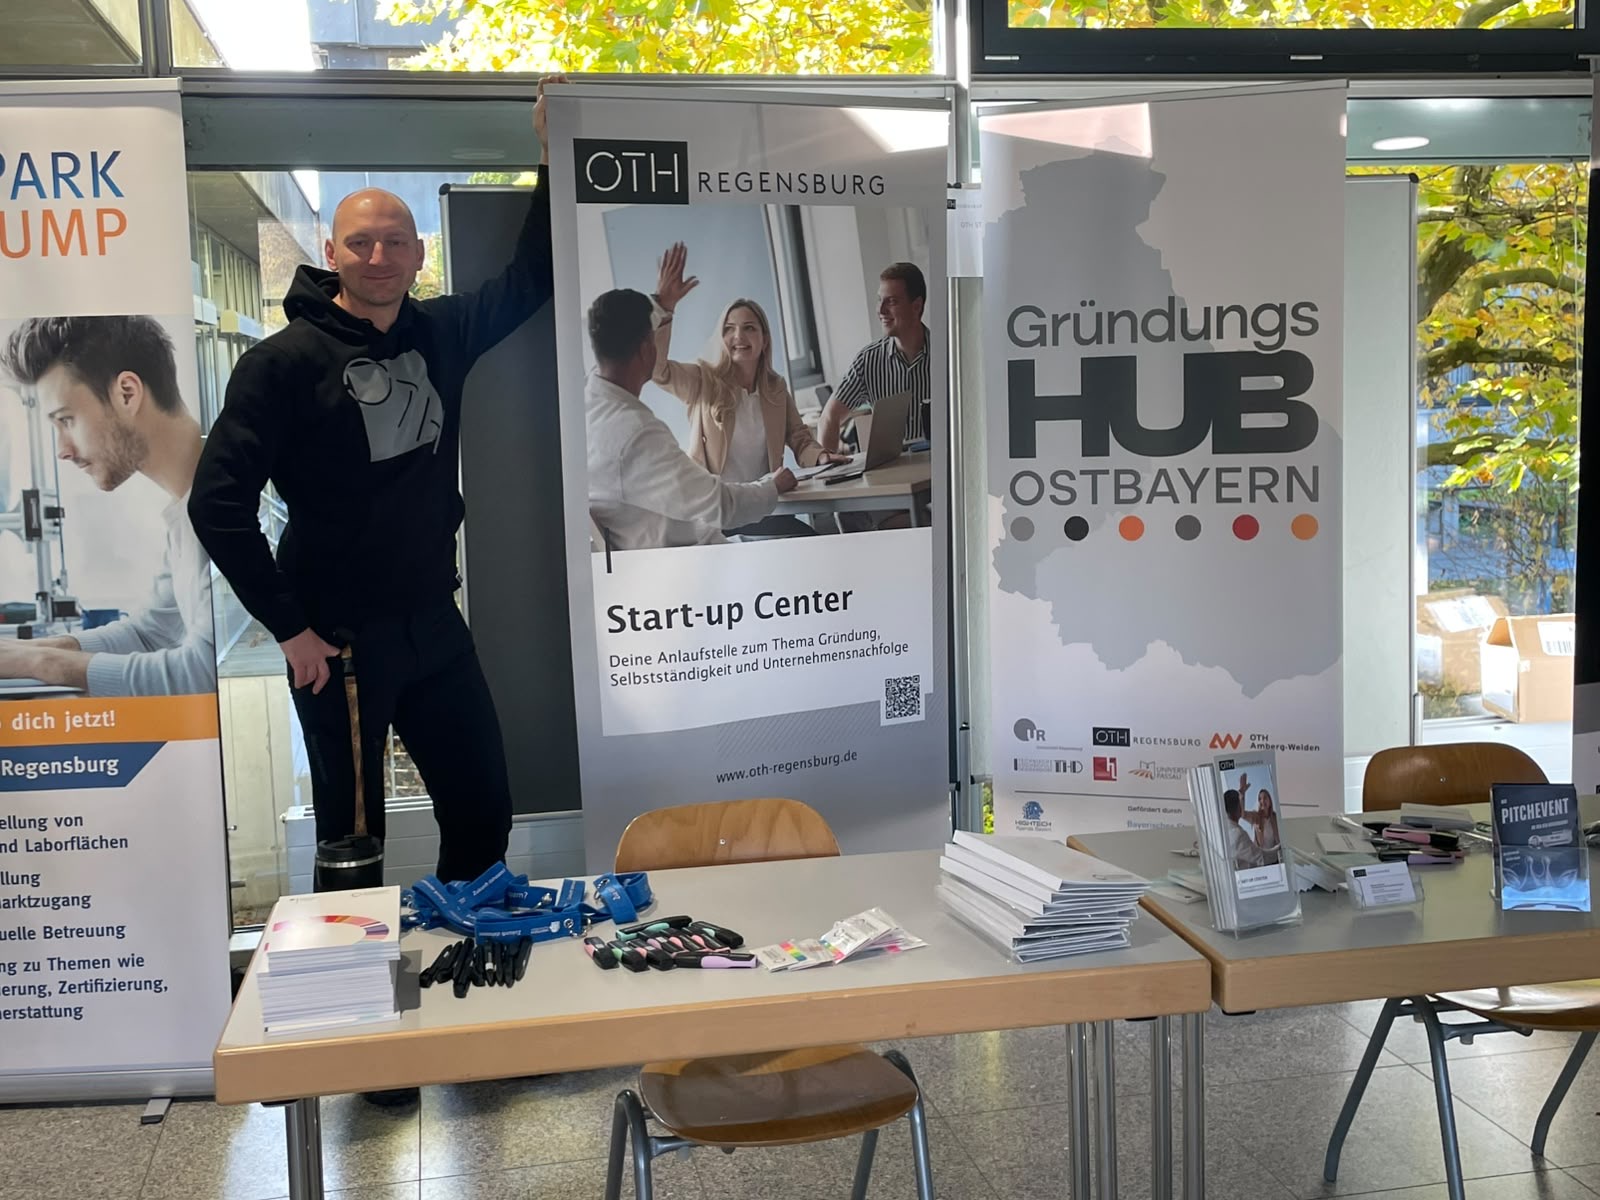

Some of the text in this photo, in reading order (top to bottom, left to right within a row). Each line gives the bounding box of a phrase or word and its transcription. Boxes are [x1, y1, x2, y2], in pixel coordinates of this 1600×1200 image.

[0, 151, 125, 200] ARK
[586, 151, 886, 196] OTH REGENSBURG
[1007, 295, 1319, 351] Gründungs
[1007, 349, 1319, 459] HUB
[1009, 465, 1320, 506] OSTBAYERN
[606, 589, 853, 634] Start-up Center
[610, 628, 881, 668] Deine Anlaufstelle zum Thema Gründung,
[610, 641, 909, 687] Selbstständigkeit und Unternehmensnachfolge
[12, 712, 55, 731] dich
[64, 710, 116, 732] jetzt!
[1095, 730, 1201, 747] OTH REGENSBURG
[1249, 734, 1269, 742] OTH
[1, 756, 119, 779] Regensburg
[716, 750, 858, 784] www.oth-regensburg.de
[54, 816, 83, 827] von
[1501, 797, 1569, 825] PITCHEVENT
[25, 835, 128, 853] Laborflächen
[43, 924, 126, 939] Betreuung
[23, 960, 41, 972] zu
[47, 956, 111, 971] Themen
[117, 953, 145, 968] wie
[58, 977, 168, 994] Zertifizierung,
